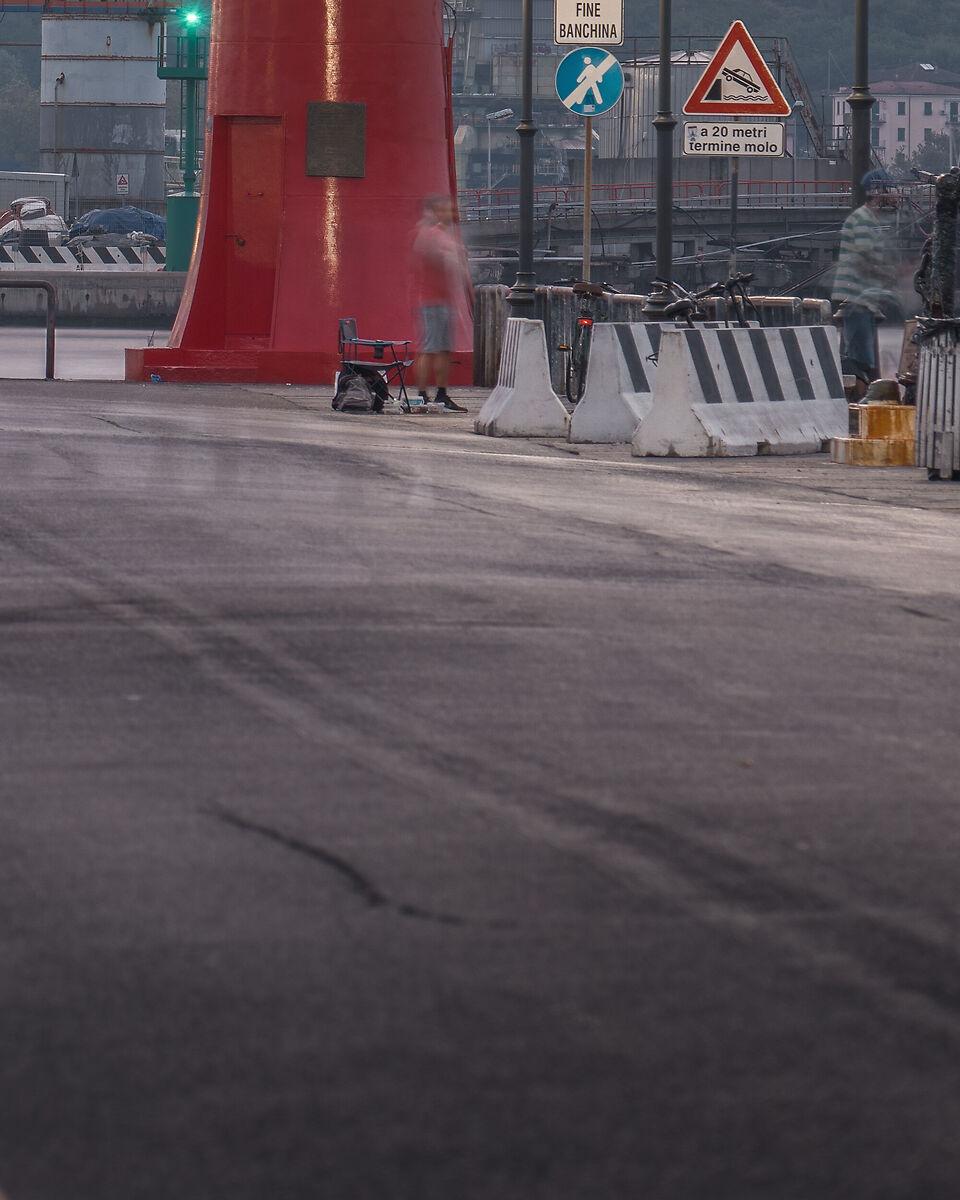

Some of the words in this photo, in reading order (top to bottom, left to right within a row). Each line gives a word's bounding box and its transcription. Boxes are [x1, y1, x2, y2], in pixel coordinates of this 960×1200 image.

[576, 3, 600, 17] FINE
[559, 23, 617, 38] BANCHINA
[700, 127, 708, 137] a
[712, 126, 728, 137] 20
[732, 127, 767, 138] metri
[689, 140, 740, 152] termine
[744, 141, 778, 152] molo
